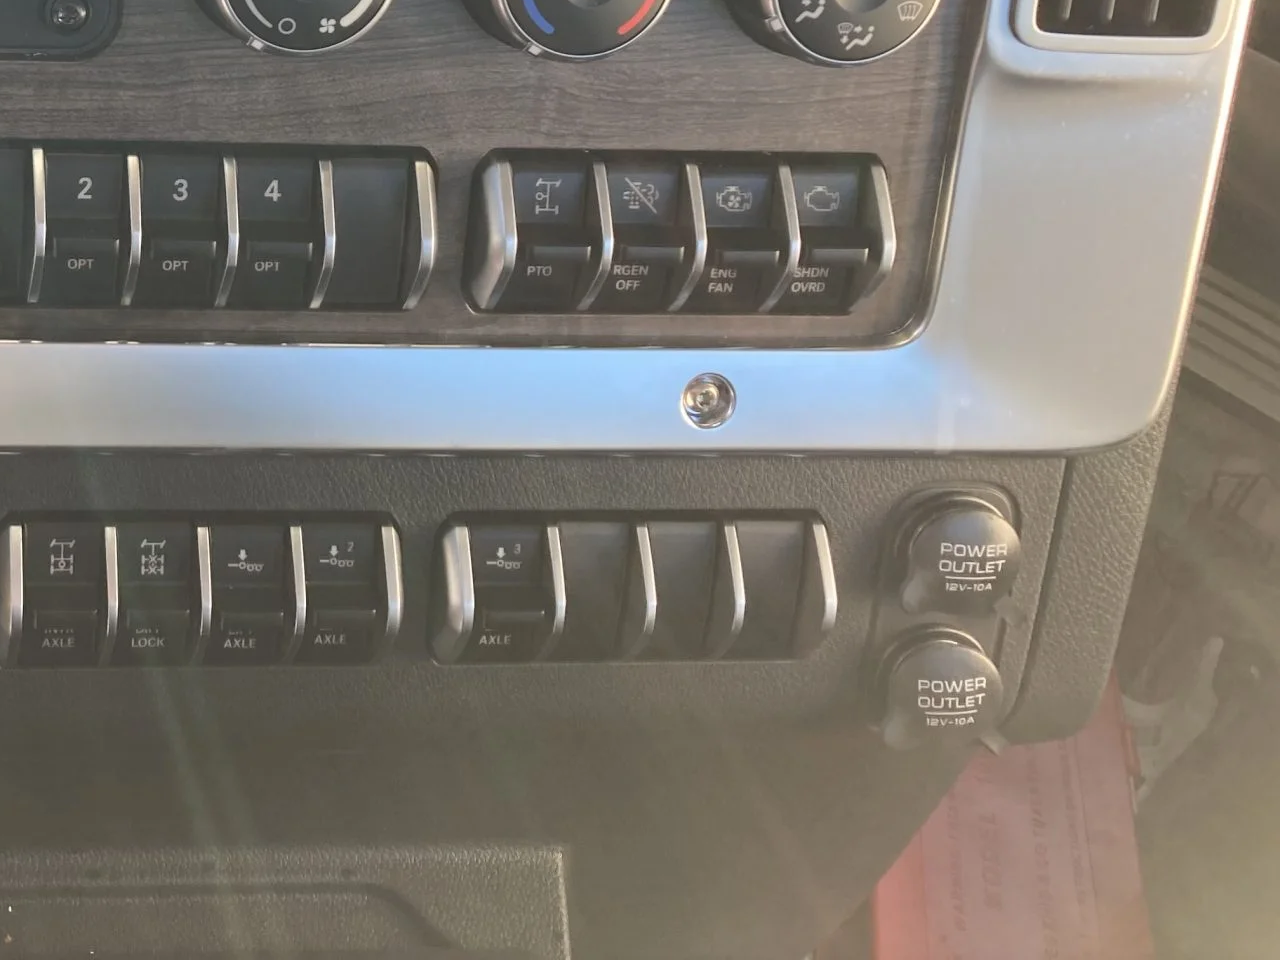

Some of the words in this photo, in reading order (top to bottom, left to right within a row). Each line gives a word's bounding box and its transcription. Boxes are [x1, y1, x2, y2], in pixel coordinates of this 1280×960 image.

[77, 177, 93, 200] 2
[172, 178, 188, 201] 3
[264, 179, 282, 202] 4
[67, 259, 94, 271] OPT
[162, 260, 189, 272] OPT
[254, 261, 280, 273] OPT
[527, 265, 553, 277] PTO
[613, 265, 649, 277] RGEN
[710, 268, 737, 280] ENG
[793, 266, 830, 279] SHDN
[615, 279, 641, 291] OFF
[708, 282, 734, 294] FAN
[791, 281, 826, 294] OVRD
[940, 542, 1008, 558] POWER
[939, 559, 1006, 574] OUTLET
[945, 582, 993, 592] 12V-10A
[42, 637, 75, 648] AXLE
[131, 637, 165, 648] LOCK
[223, 638, 256, 649] AXLE
[314, 634, 347, 645] AXLE
[479, 634, 512, 645] AXLE
[918, 676, 987, 693] POWER
[918, 693, 986, 709] OUTLET
[926, 716, 975, 727] 12V-10A
